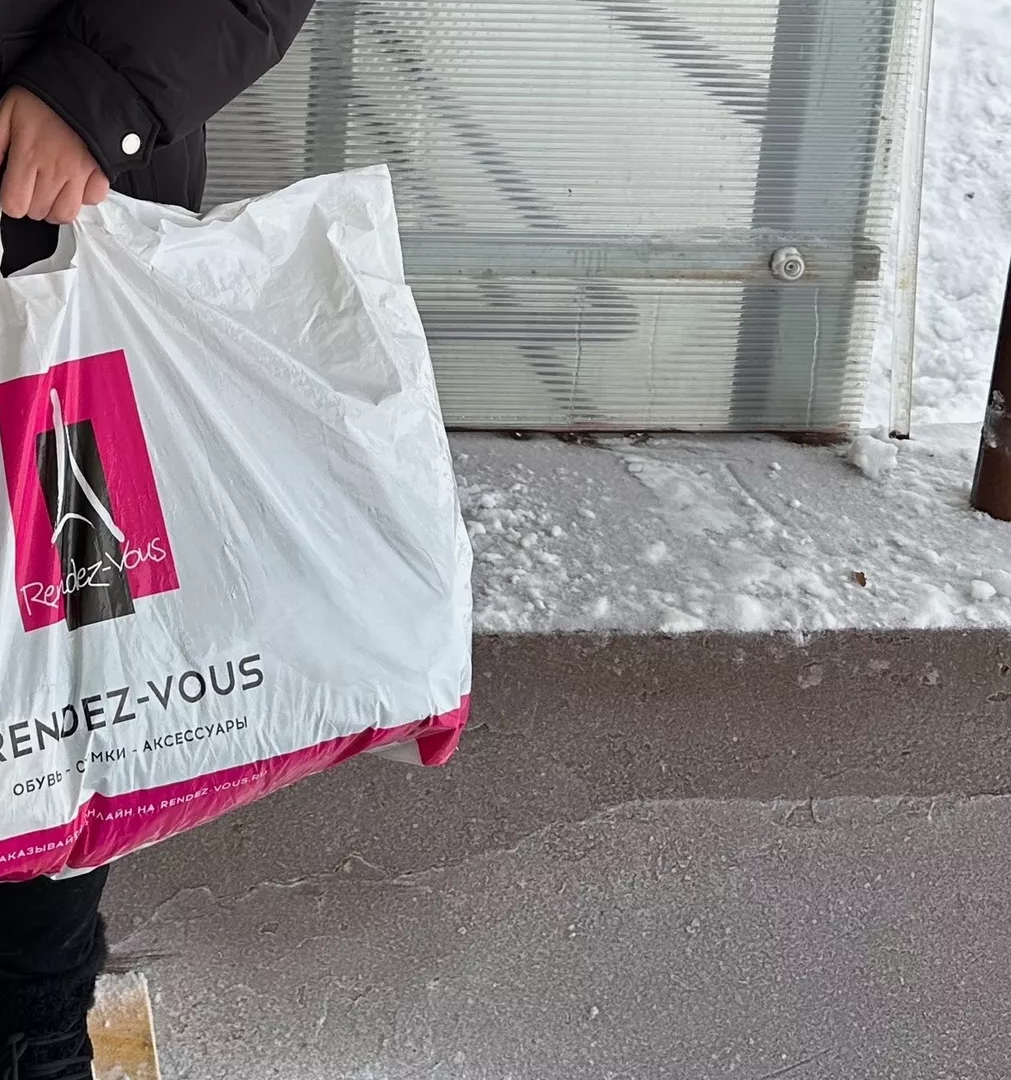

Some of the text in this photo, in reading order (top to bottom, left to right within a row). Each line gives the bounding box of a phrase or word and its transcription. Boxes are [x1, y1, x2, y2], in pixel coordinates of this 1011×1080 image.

[13, 772, 63, 796] ОБУВЬ
[76, 747, 126, 774] СМКИ
[142, 716, 248, 753] АКСЕССУАРЫ
[138, 805, 155, 816] НА
